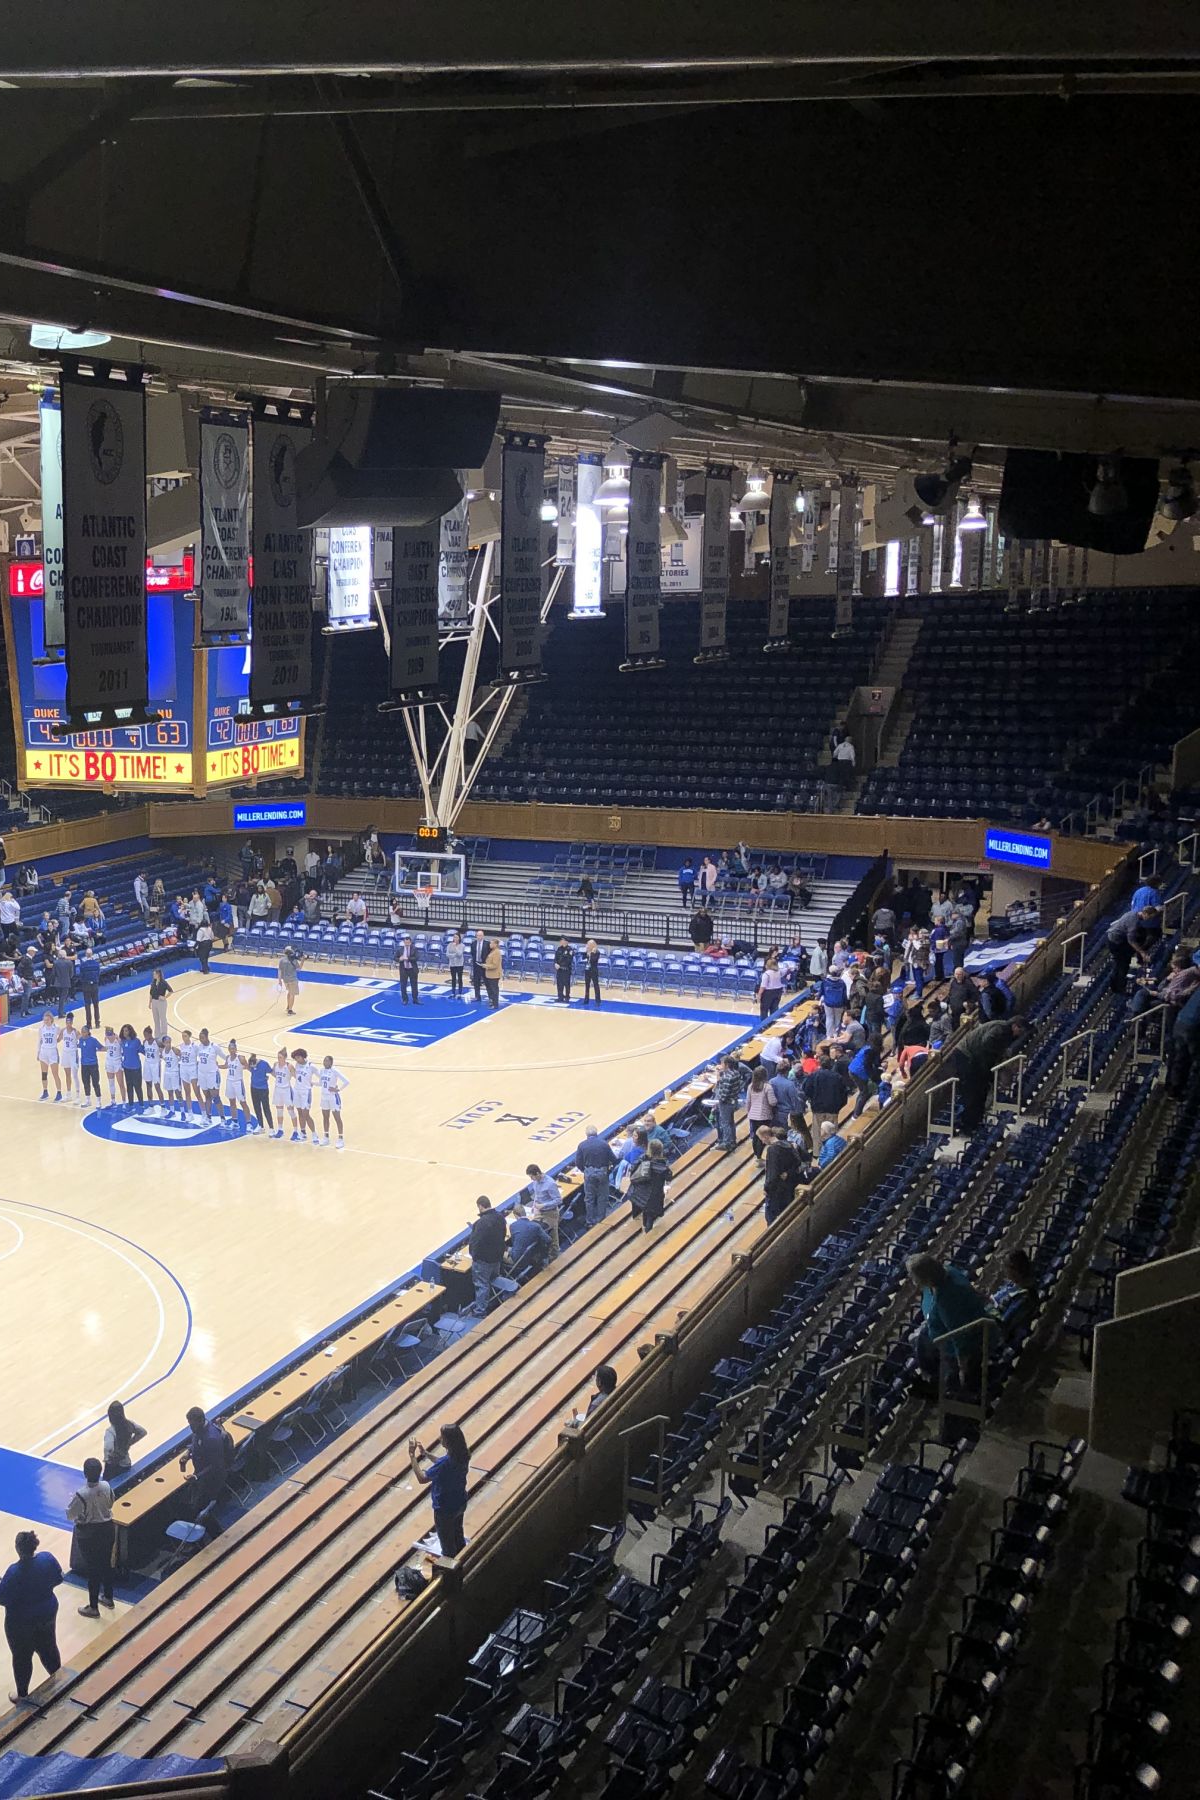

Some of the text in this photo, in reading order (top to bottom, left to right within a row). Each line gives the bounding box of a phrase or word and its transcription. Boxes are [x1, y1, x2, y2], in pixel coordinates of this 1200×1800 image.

[82, 515, 136, 538] ATLANTIC
[92, 546, 128, 568] COAST
[99, 669, 129, 692] 2011
[33, 708, 60, 719] DUKE
[214, 706, 232, 717] DUKE
[156, 723, 180, 744] 63
[216, 720, 230, 740] 42
[49, 750, 167, 782] IT'S BO TIME!
[220, 743, 287, 777] IT'S BO TIME!
[237, 810, 303, 822] MILLERLENDING.COM
[988, 839, 1049, 859] MILLERLENDING.COM
[302, 1027, 437, 1043] ACC
[446, 1101, 503, 1130] COURT
[494, 1113, 540, 1127] K
[528, 1111, 585, 1142] COACH
